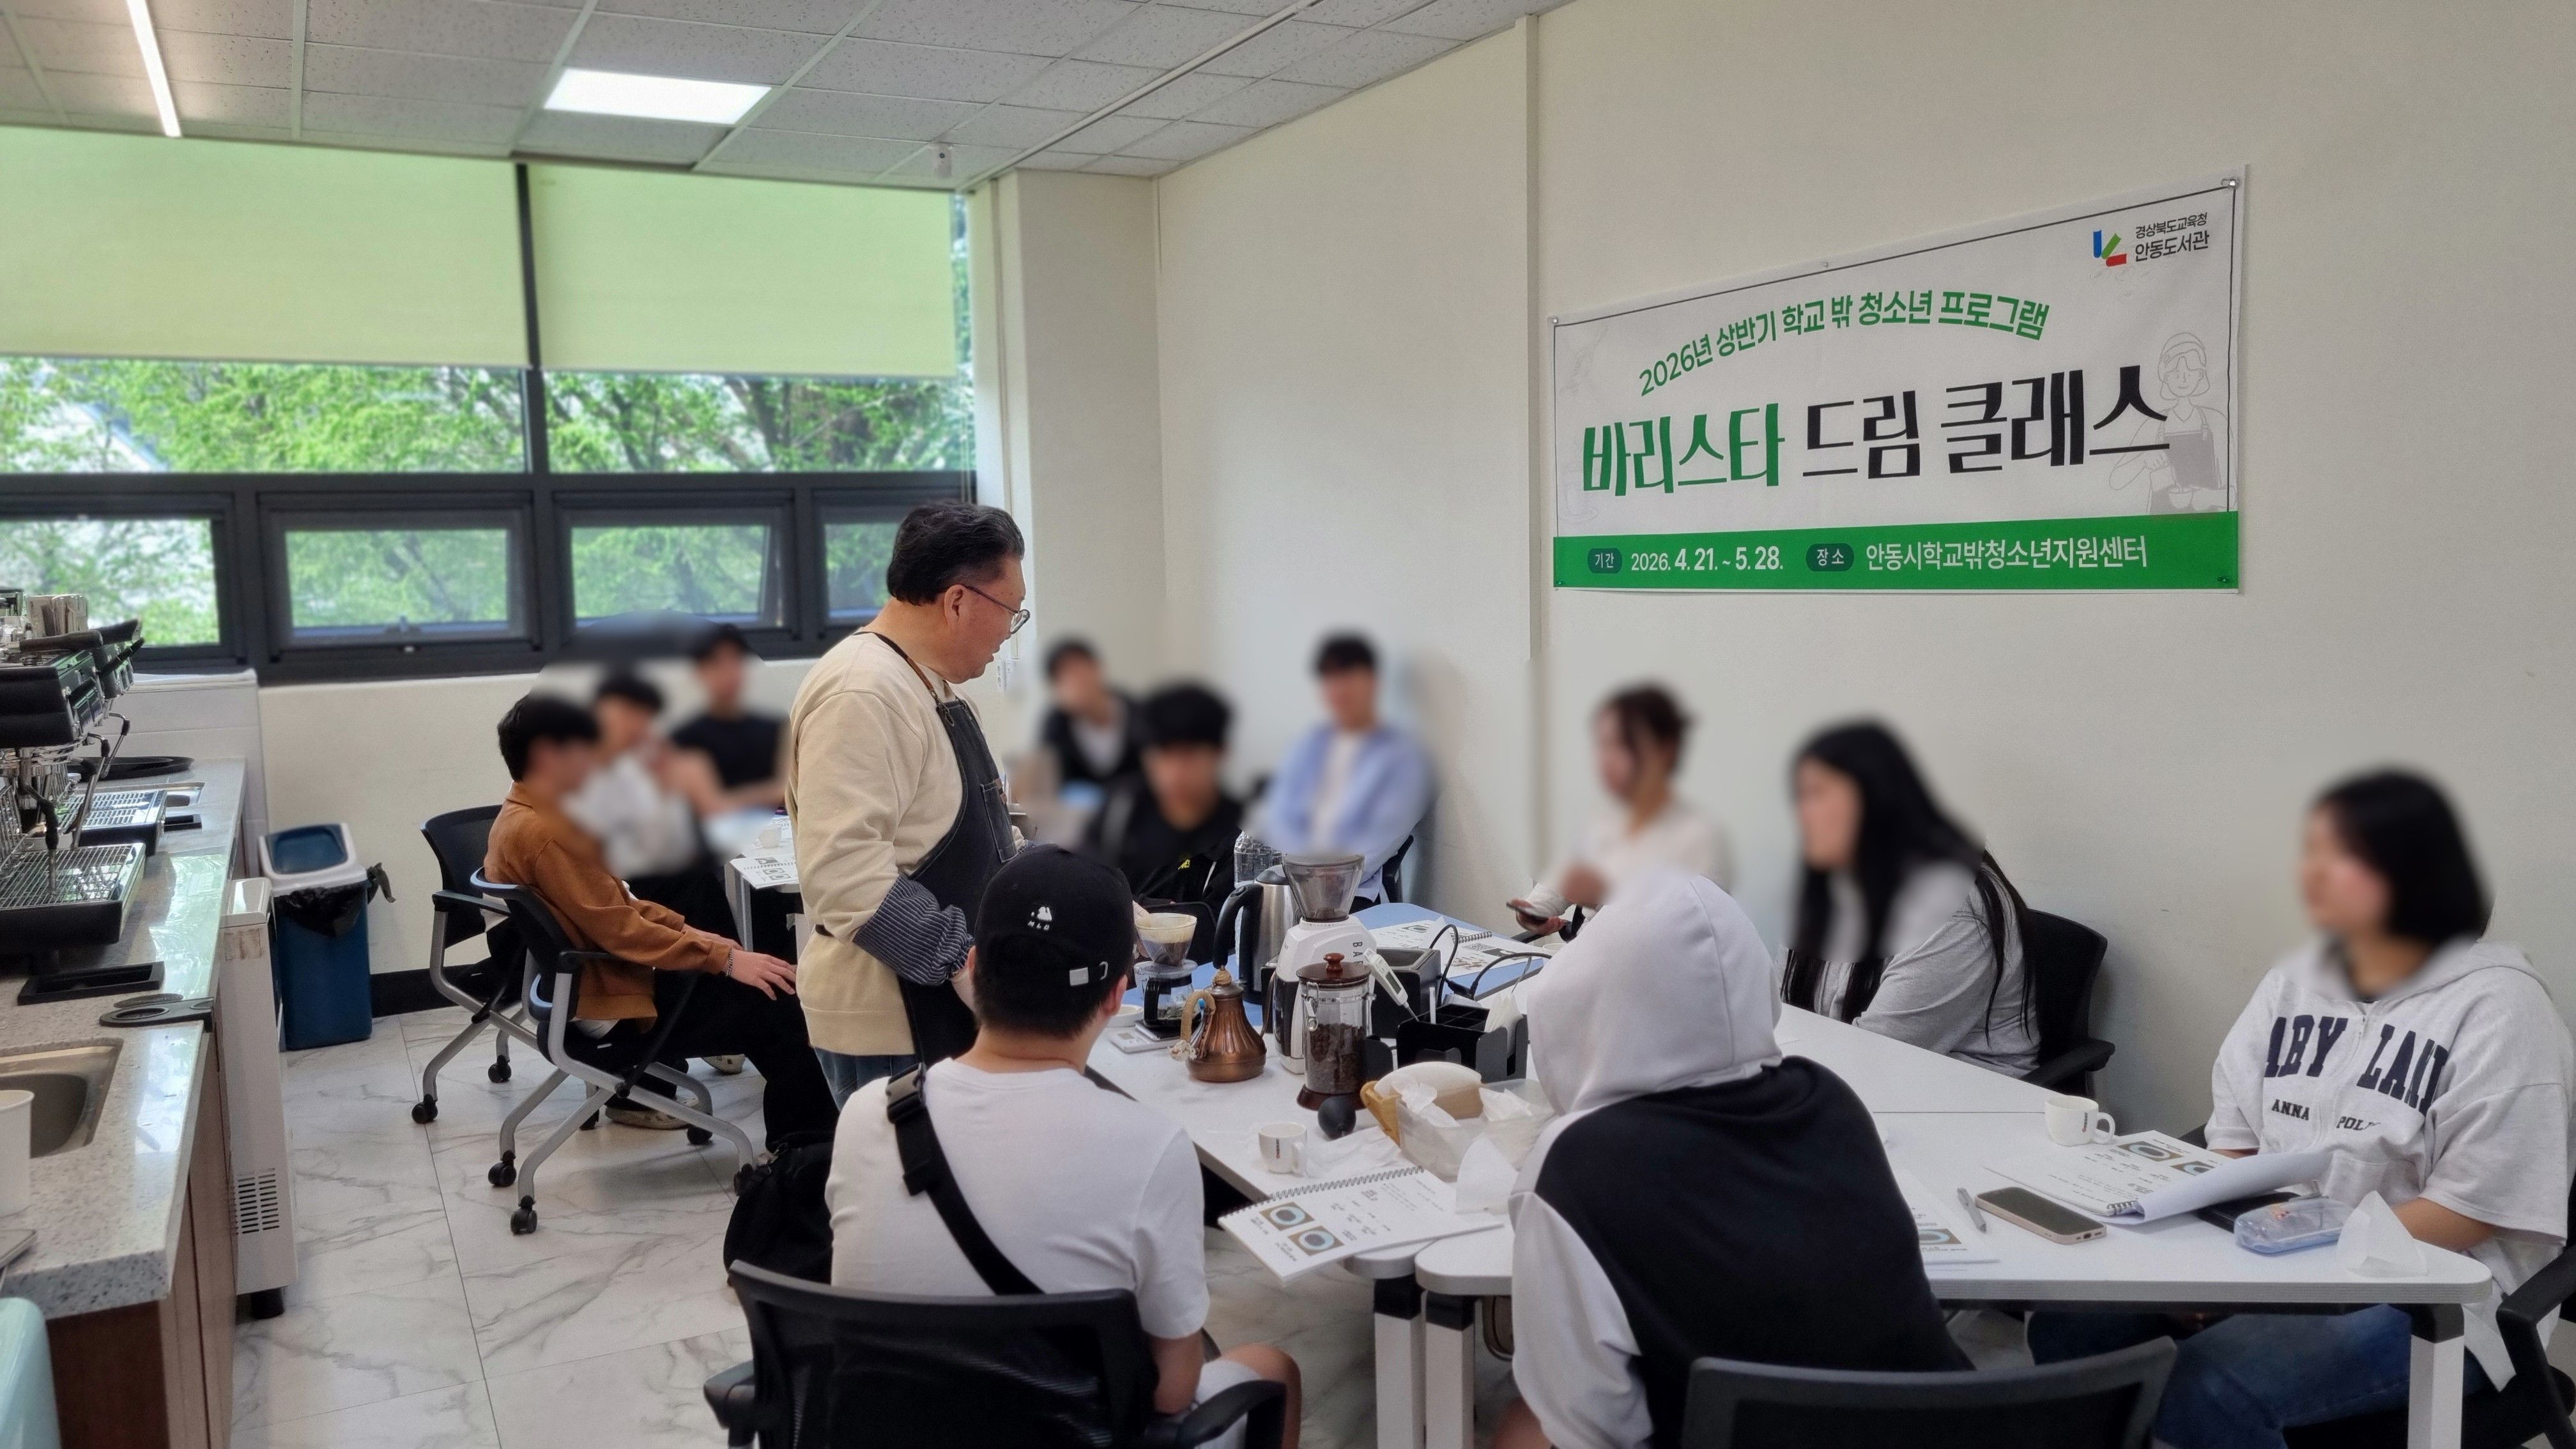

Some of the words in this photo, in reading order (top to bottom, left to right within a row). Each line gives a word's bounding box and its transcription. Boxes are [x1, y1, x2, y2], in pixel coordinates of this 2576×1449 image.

[2135, 212, 2207, 239] 경상북도교육청
[2135, 230, 2210, 262] 안동도서관
[1639, 334, 1713, 396] 2026년
[1716, 312, 1777, 357] 상반기
[1782, 295, 1825, 335] 학교
[1831, 295, 1853, 328] 밖
[1859, 290, 1933, 326] 청소년
[1938, 291, 2050, 341] 프로그램
[1583, 403, 1785, 496] 바리스타
[1802, 390, 1920, 479] 드림
[1940, 365, 2170, 474] 클래스
[1595, 553, 1614, 569] 기간
[1631, 553, 1671, 571] 2026.
[1866, 535, 2147, 571] 안동시학교밖청소년지원센터
[2271, 1099, 2310, 1121] ANNA
[2336, 1116, 2380, 1131] POL
